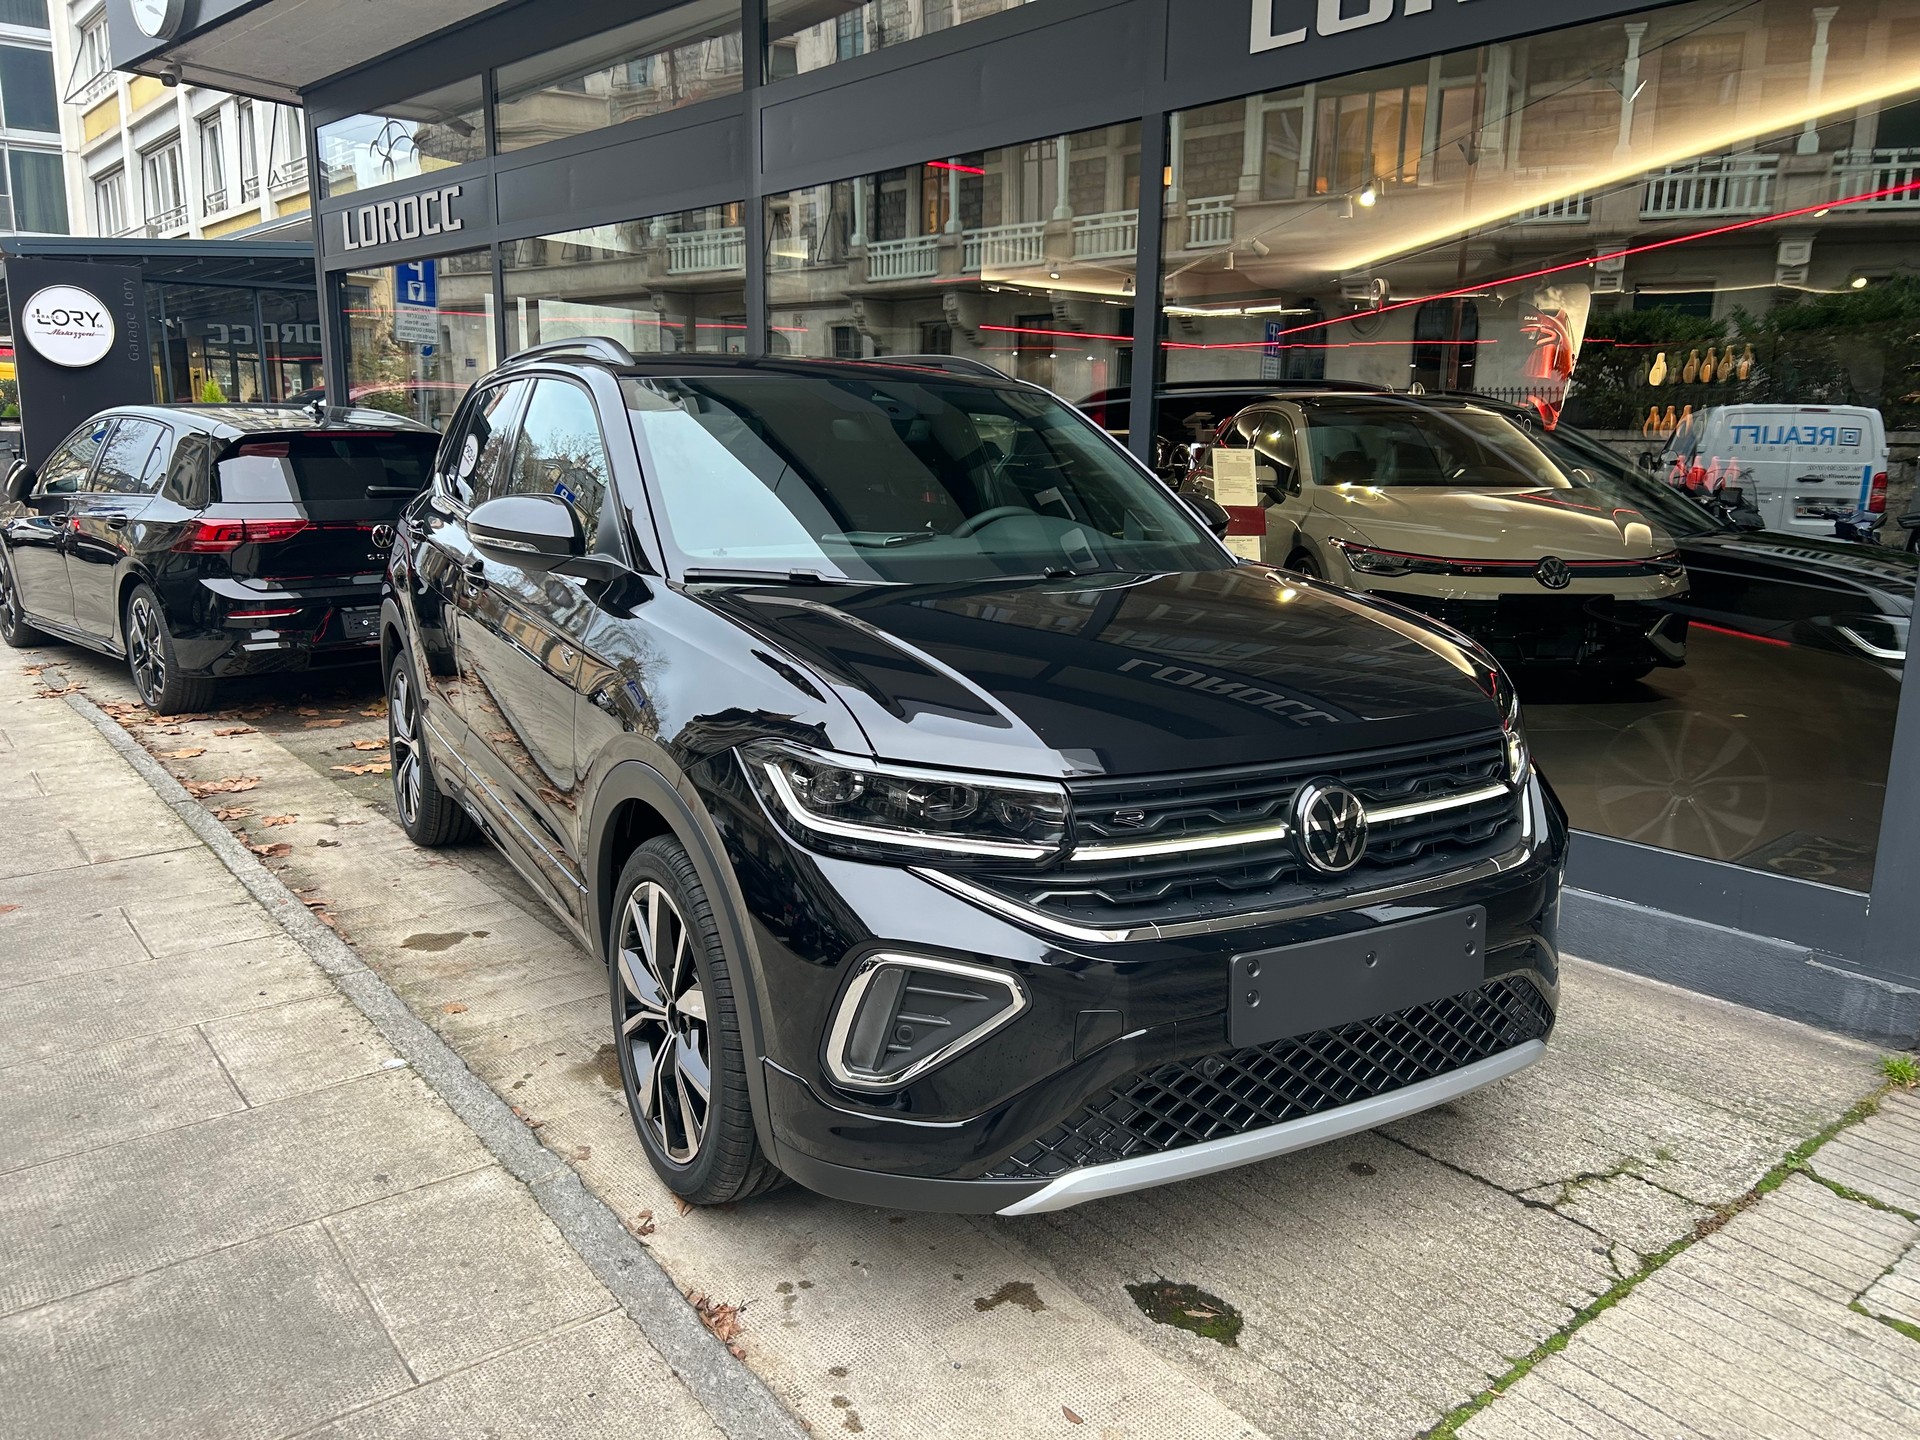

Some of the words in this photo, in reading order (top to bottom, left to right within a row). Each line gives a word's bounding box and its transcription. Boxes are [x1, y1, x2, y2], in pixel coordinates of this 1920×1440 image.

[341, 185, 462, 251] LOROCC
[123, 277, 136, 307] Lory
[36, 308, 101, 328] LORY
[127, 312, 140, 361] Garage
